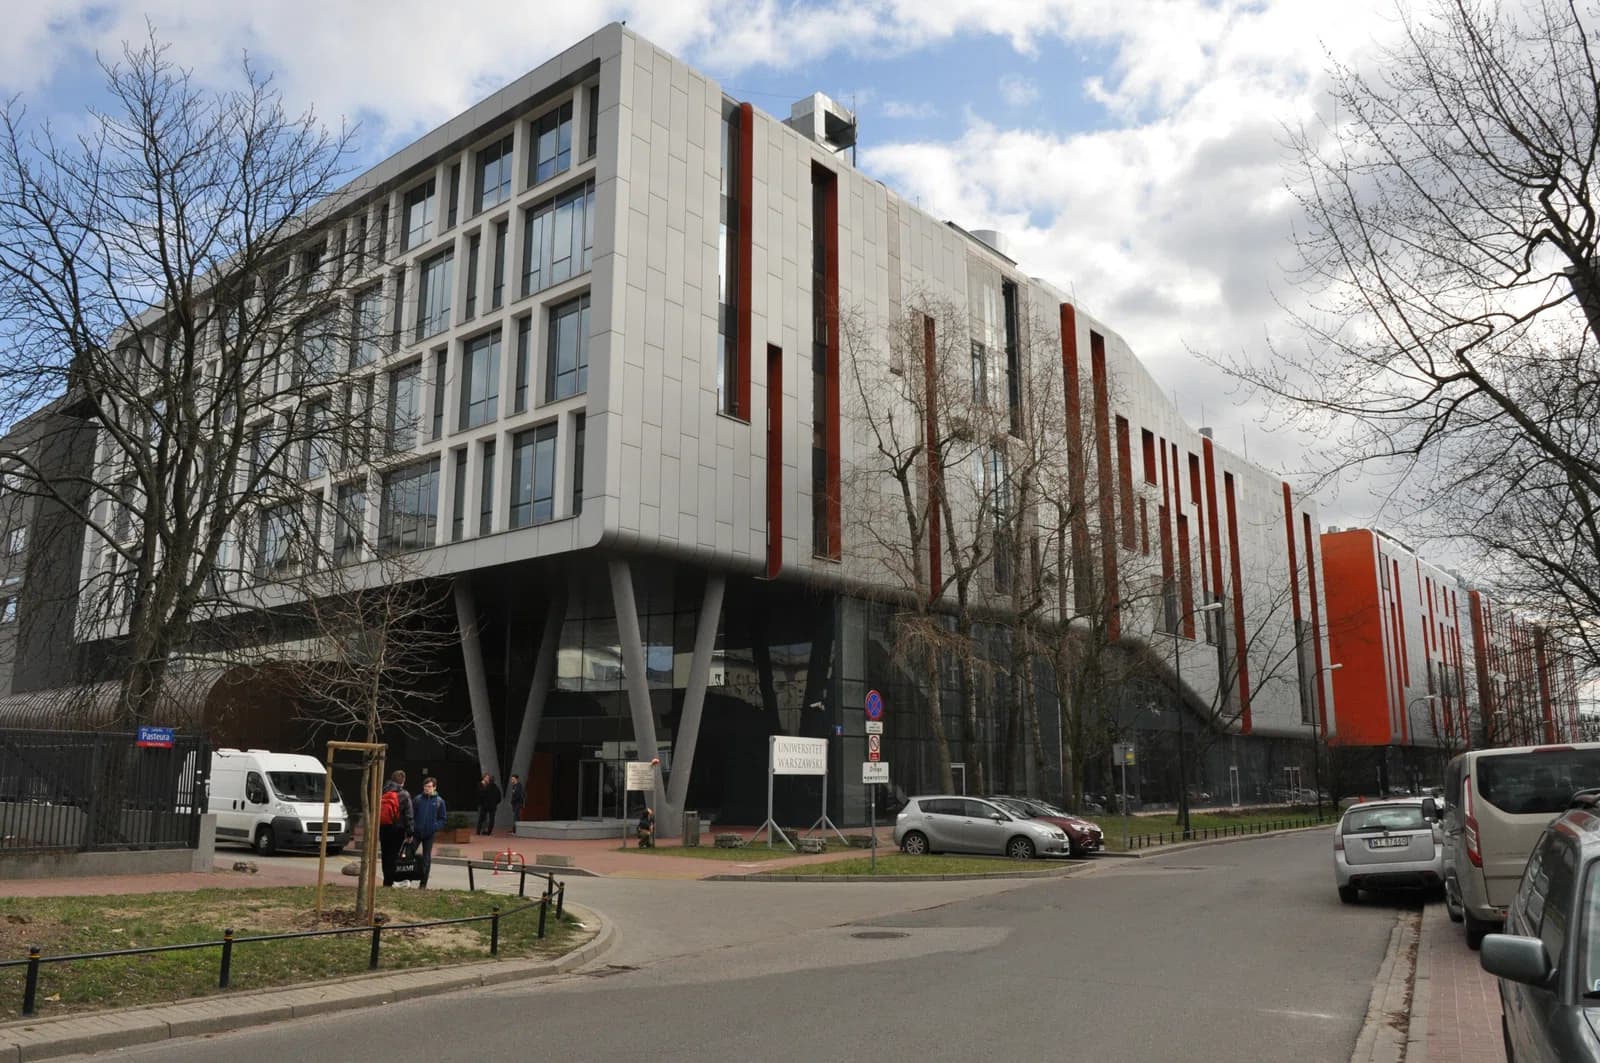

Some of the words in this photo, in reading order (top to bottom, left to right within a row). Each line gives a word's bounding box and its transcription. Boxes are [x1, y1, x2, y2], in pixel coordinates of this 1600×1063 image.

[142, 731, 170, 741] Pasteura
[778, 743, 824, 754] UNIWERSYTET
[777, 759, 823, 769] WARSZAWSKI
